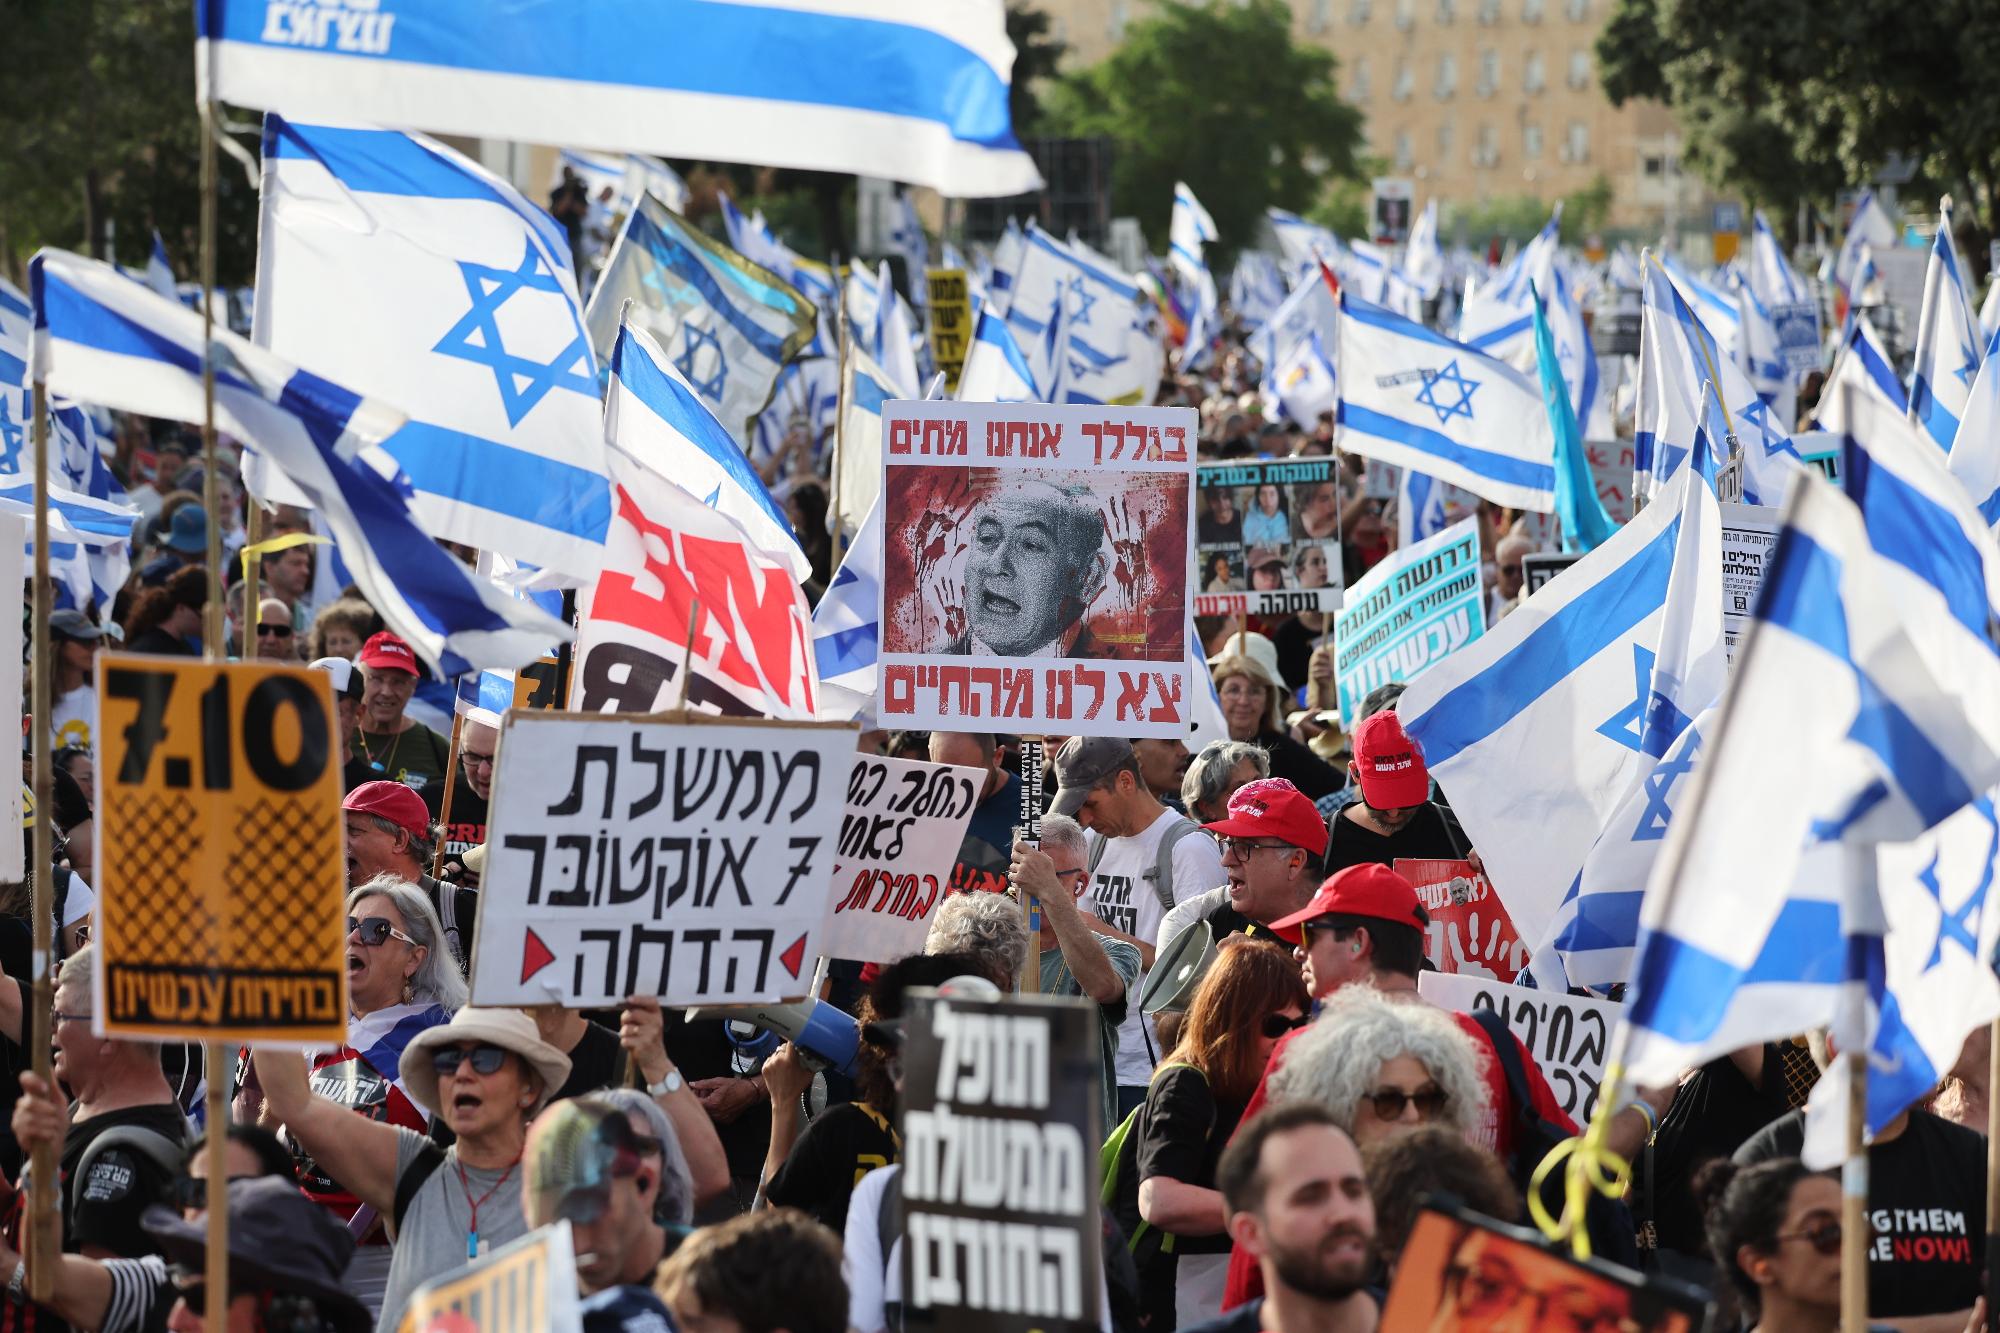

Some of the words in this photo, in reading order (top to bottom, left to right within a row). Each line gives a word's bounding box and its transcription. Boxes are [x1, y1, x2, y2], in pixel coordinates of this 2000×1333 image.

[890, 419, 968, 455] מתים
[987, 421, 1063, 458] אנחנו
[1082, 420, 1187, 465] בגללך
[1397, 539, 1472, 596] דרושה
[1728, 551, 1761, 564] חיילים
[1339, 584, 1391, 641] הנהגה
[1416, 572, 1476, 614] שתחזיר
[1393, 609, 1413, 631] את
[884, 665, 1033, 718] מהחיים
[1045, 664, 1105, 720] לנו
[1117, 671, 1181, 723] צא
[106, 669, 329, 792] 7.10
[547, 731, 820, 824] ממשלת
[774, 836, 822, 906] 7
[1093, 874, 1135, 905] אתה
[573, 923, 775, 997] הדחה
[114, 968, 226, 1025] עכשיו!
[231, 975, 337, 1020] בחירות
[902, 1102, 1085, 1216] ממשלת
[1893, 1207, 1967, 1236] THEM
[908, 1211, 1083, 1321] החורבן
[1894, 1235, 1972, 1265] NOW!
